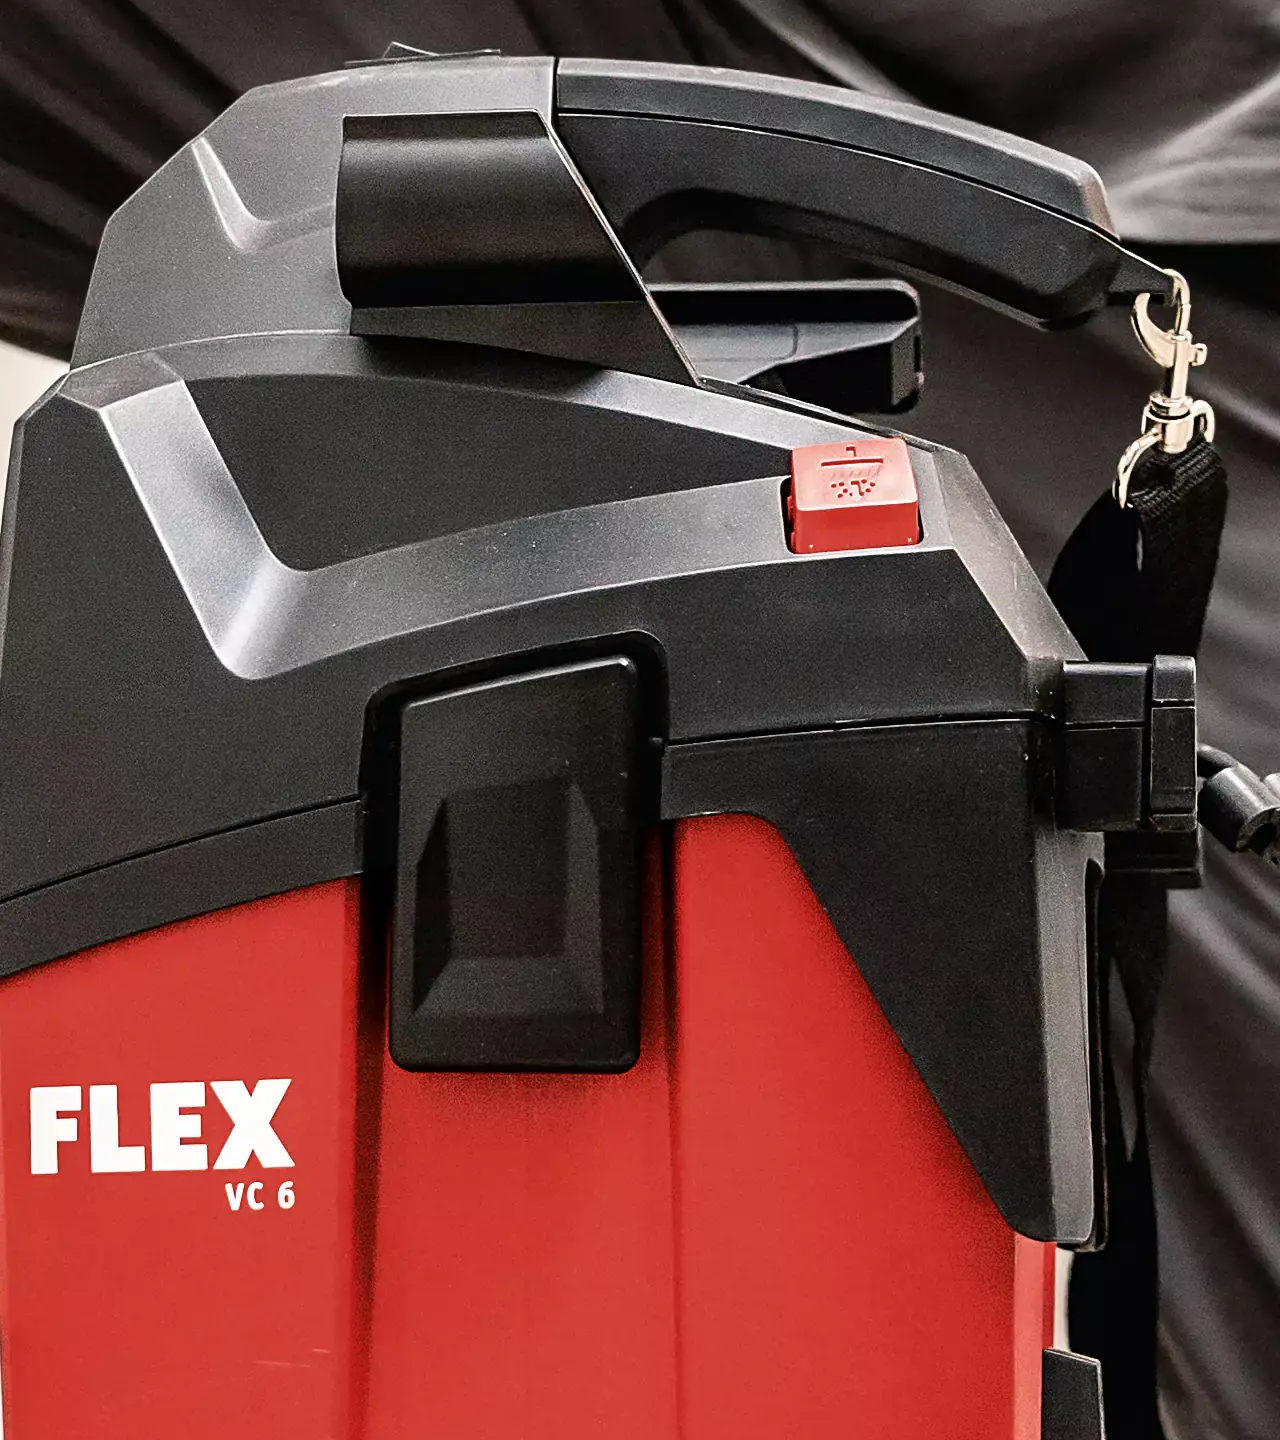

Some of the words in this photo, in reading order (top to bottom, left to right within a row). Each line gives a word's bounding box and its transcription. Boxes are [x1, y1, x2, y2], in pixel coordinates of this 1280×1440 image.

[30, 1078, 296, 1175] FLEX
[224, 1181, 265, 1211] VC
[277, 1180, 296, 1210] 6
